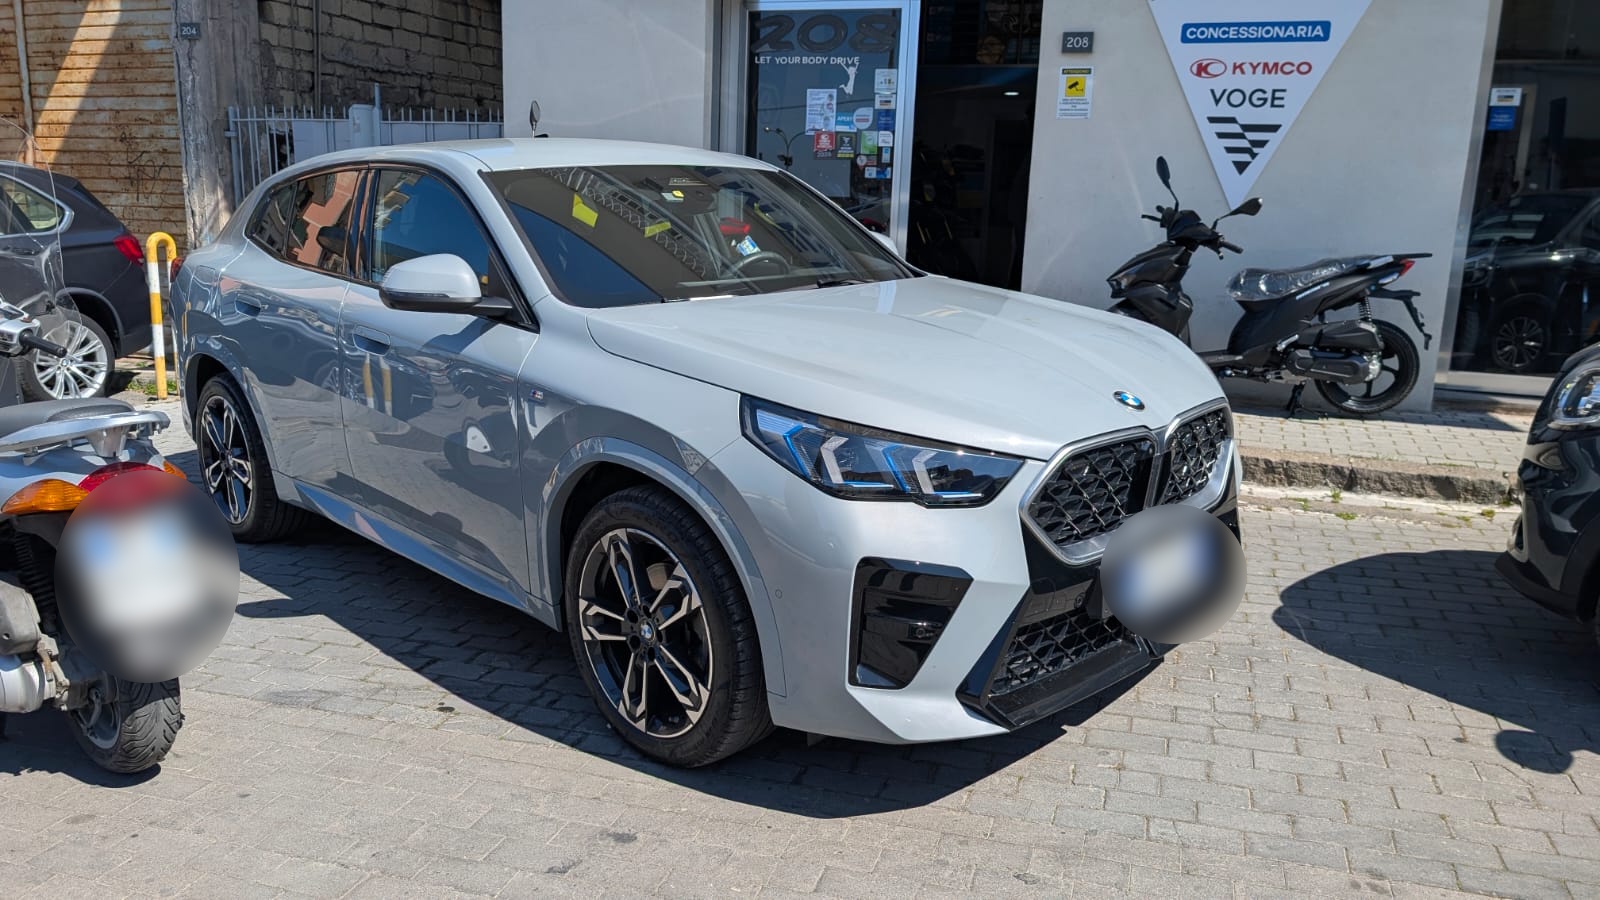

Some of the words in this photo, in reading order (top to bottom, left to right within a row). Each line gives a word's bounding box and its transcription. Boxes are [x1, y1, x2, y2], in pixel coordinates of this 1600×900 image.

[182, 26, 196, 35] 204
[752, 15, 898, 53] 208
[1186, 25, 1324, 39] CONCESSIONARIA
[1066, 37, 1089, 48] 208
[755, 56, 771, 64] LET
[775, 56, 800, 64] YOUR
[802, 56, 828, 64] BODY
[830, 56, 860, 65] DRIVE
[1232, 61, 1312, 76] KYMCO
[1210, 88, 1287, 108] VOGE
